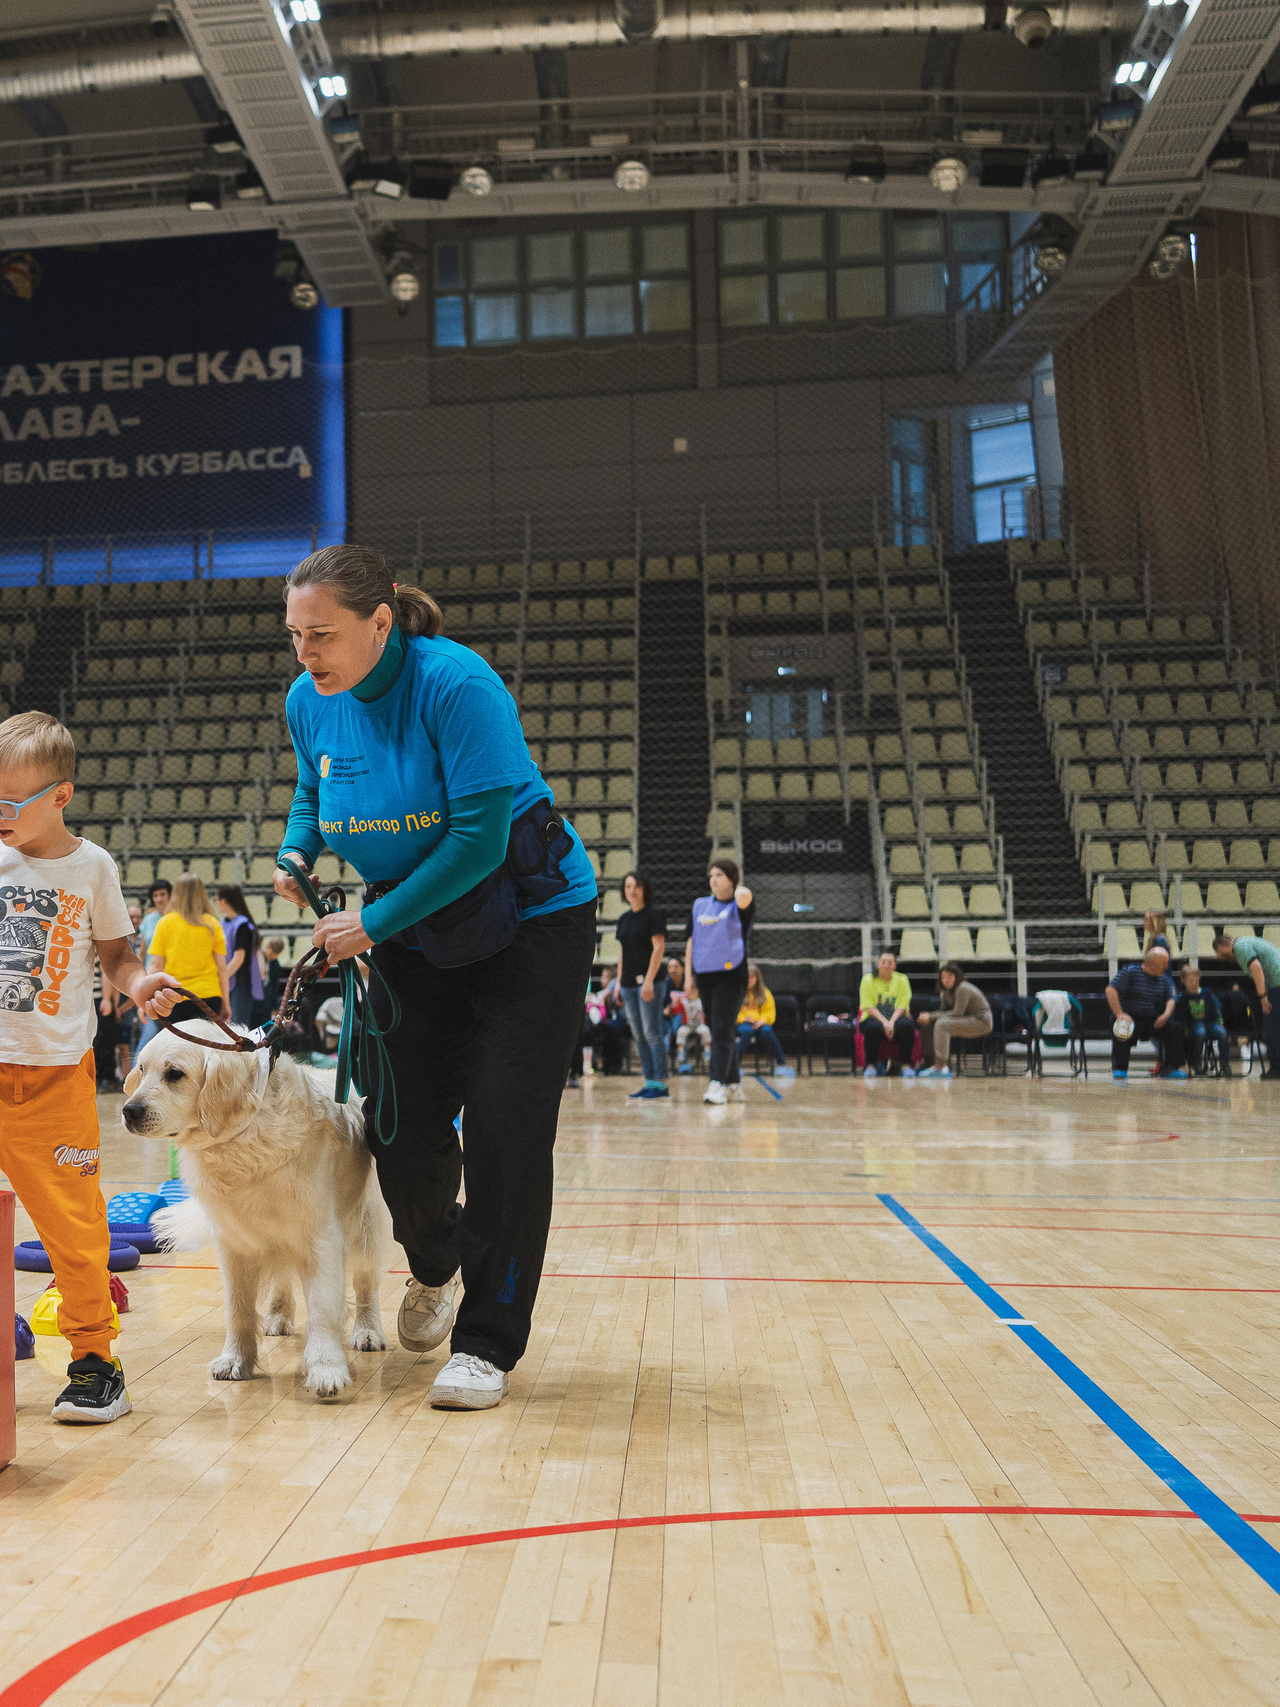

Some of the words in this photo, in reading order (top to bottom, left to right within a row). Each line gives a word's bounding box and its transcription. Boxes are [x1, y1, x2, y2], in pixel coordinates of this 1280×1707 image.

[136, 445, 309, 477] КУЗБАССА
[318, 820, 343, 834] оект
[349, 816, 400, 835] Доктор
[405, 811, 441, 832] Пёс
[38, 925, 75, 1016] BOYS
